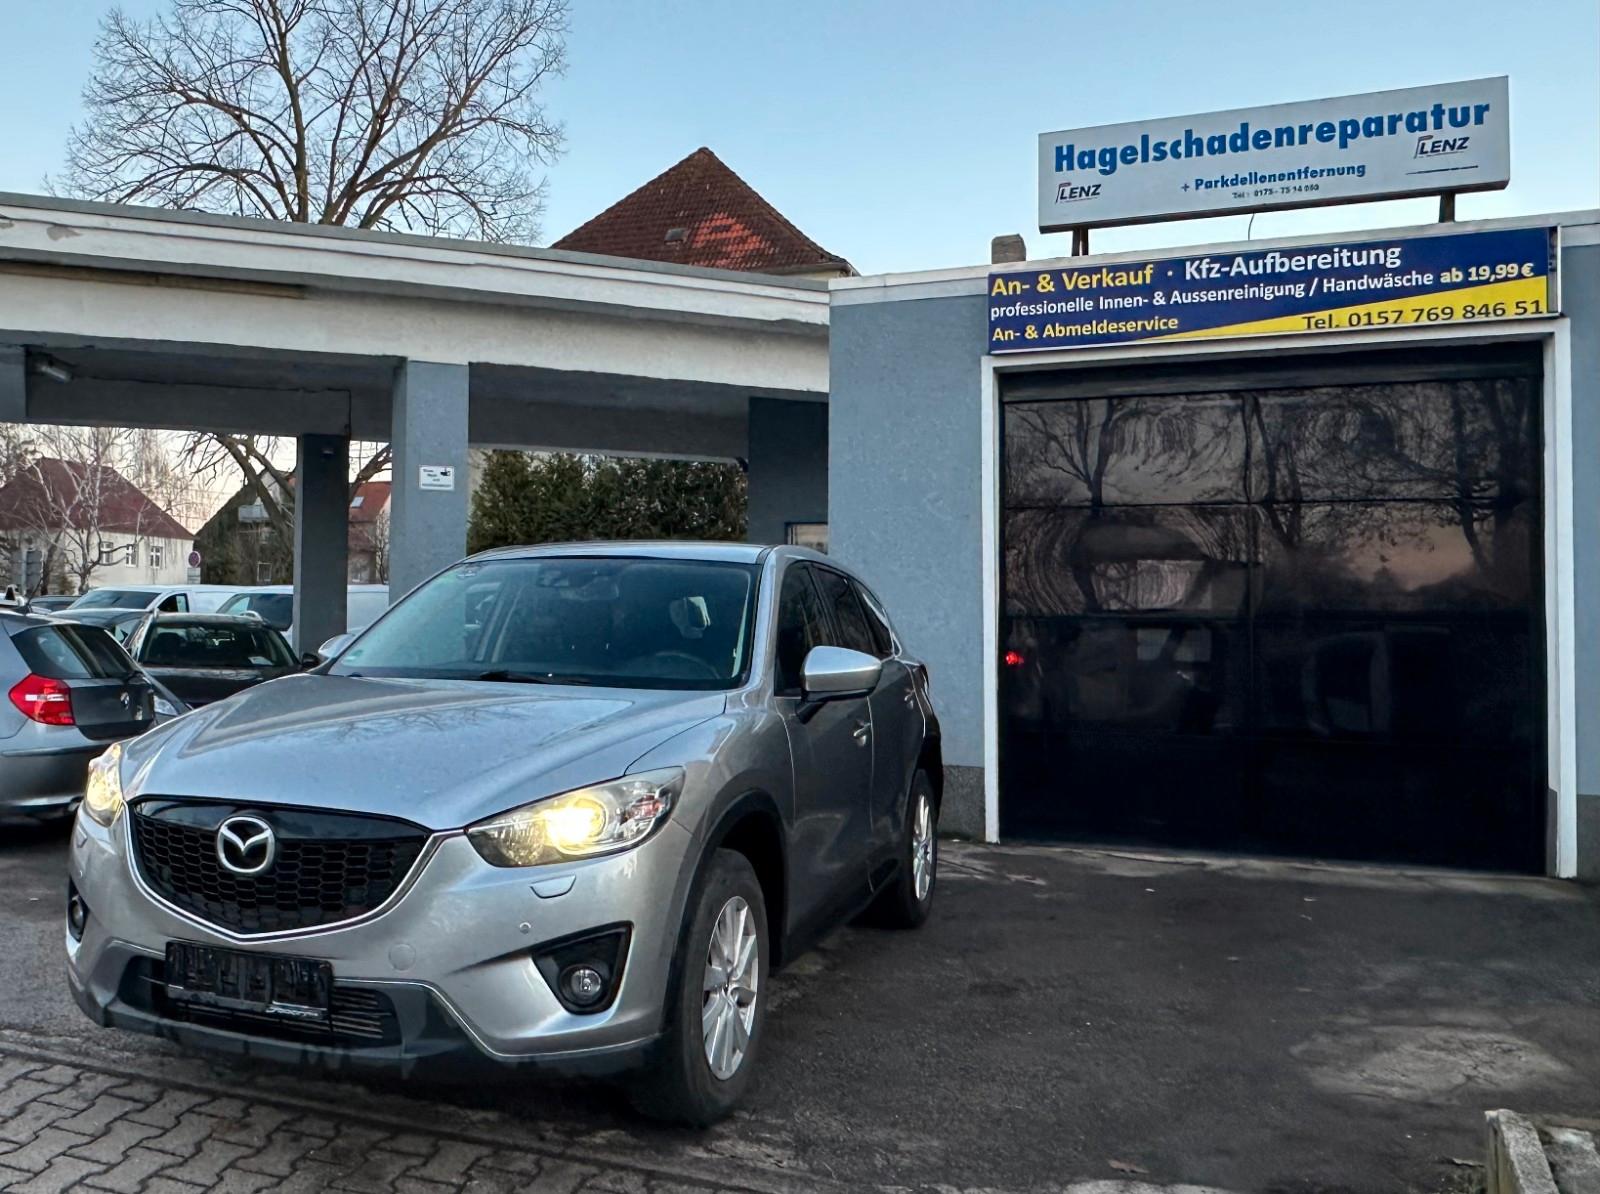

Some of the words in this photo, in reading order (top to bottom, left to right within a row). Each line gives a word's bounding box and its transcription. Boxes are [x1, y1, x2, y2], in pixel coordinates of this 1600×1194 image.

[1055, 103, 1490, 176] Hagelschadenreparatur
[1417, 136, 1470, 155] LENZ
[1058, 183, 1102, 201] LENZ
[1185, 247, 1402, 280] Kfz-Aufbereitung
[990, 297, 1094, 321] professionelle
[1099, 295, 1149, 310] Innen-
[1152, 291, 1166, 306] &
[1170, 283, 1305, 304] Aussenreinigung
[1323, 270, 1434, 293] Handwäsche
[1440, 267, 1463, 284] ab
[991, 278, 1030, 296] An-
[1036, 273, 1055, 293] &
[1062, 264, 1154, 290] Verkauf
[992, 328, 1020, 341] An-
[1024, 324, 1038, 340] &
[1043, 316, 1179, 338] Abmeldeservice
[1302, 314, 1340, 330] Tel.
[1348, 309, 1404, 327] 0157
[1411, 306, 1455, 323] 769
[1462, 302, 1506, 319] 846
[1514, 299, 1543, 316] 51
